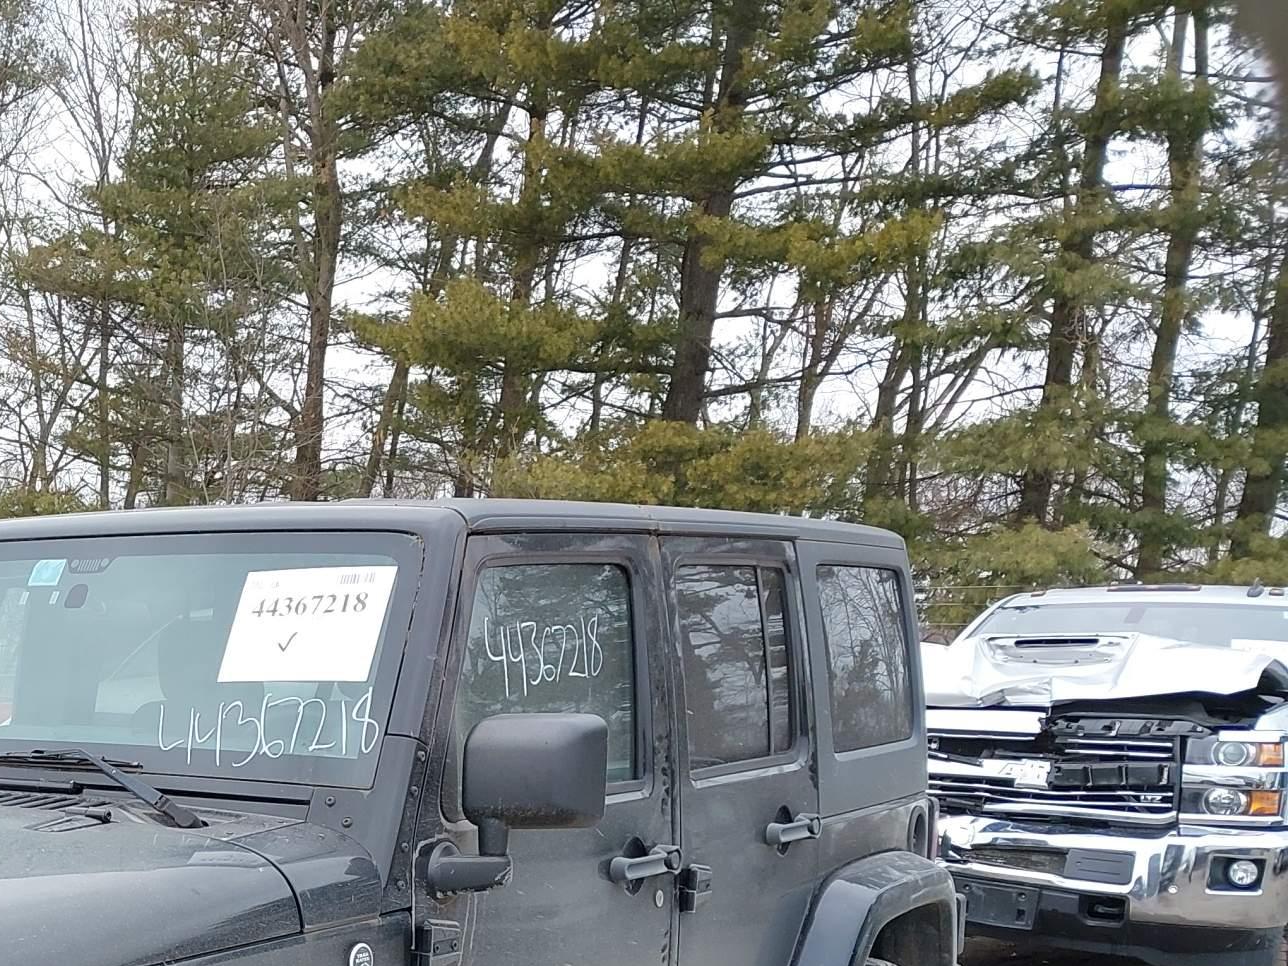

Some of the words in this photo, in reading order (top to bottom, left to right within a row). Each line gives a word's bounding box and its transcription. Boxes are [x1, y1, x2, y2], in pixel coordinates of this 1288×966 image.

[251, 592, 369, 617] 44367218
[484, 614, 603, 699] 44367218
[158, 686, 379, 767] 44367218
